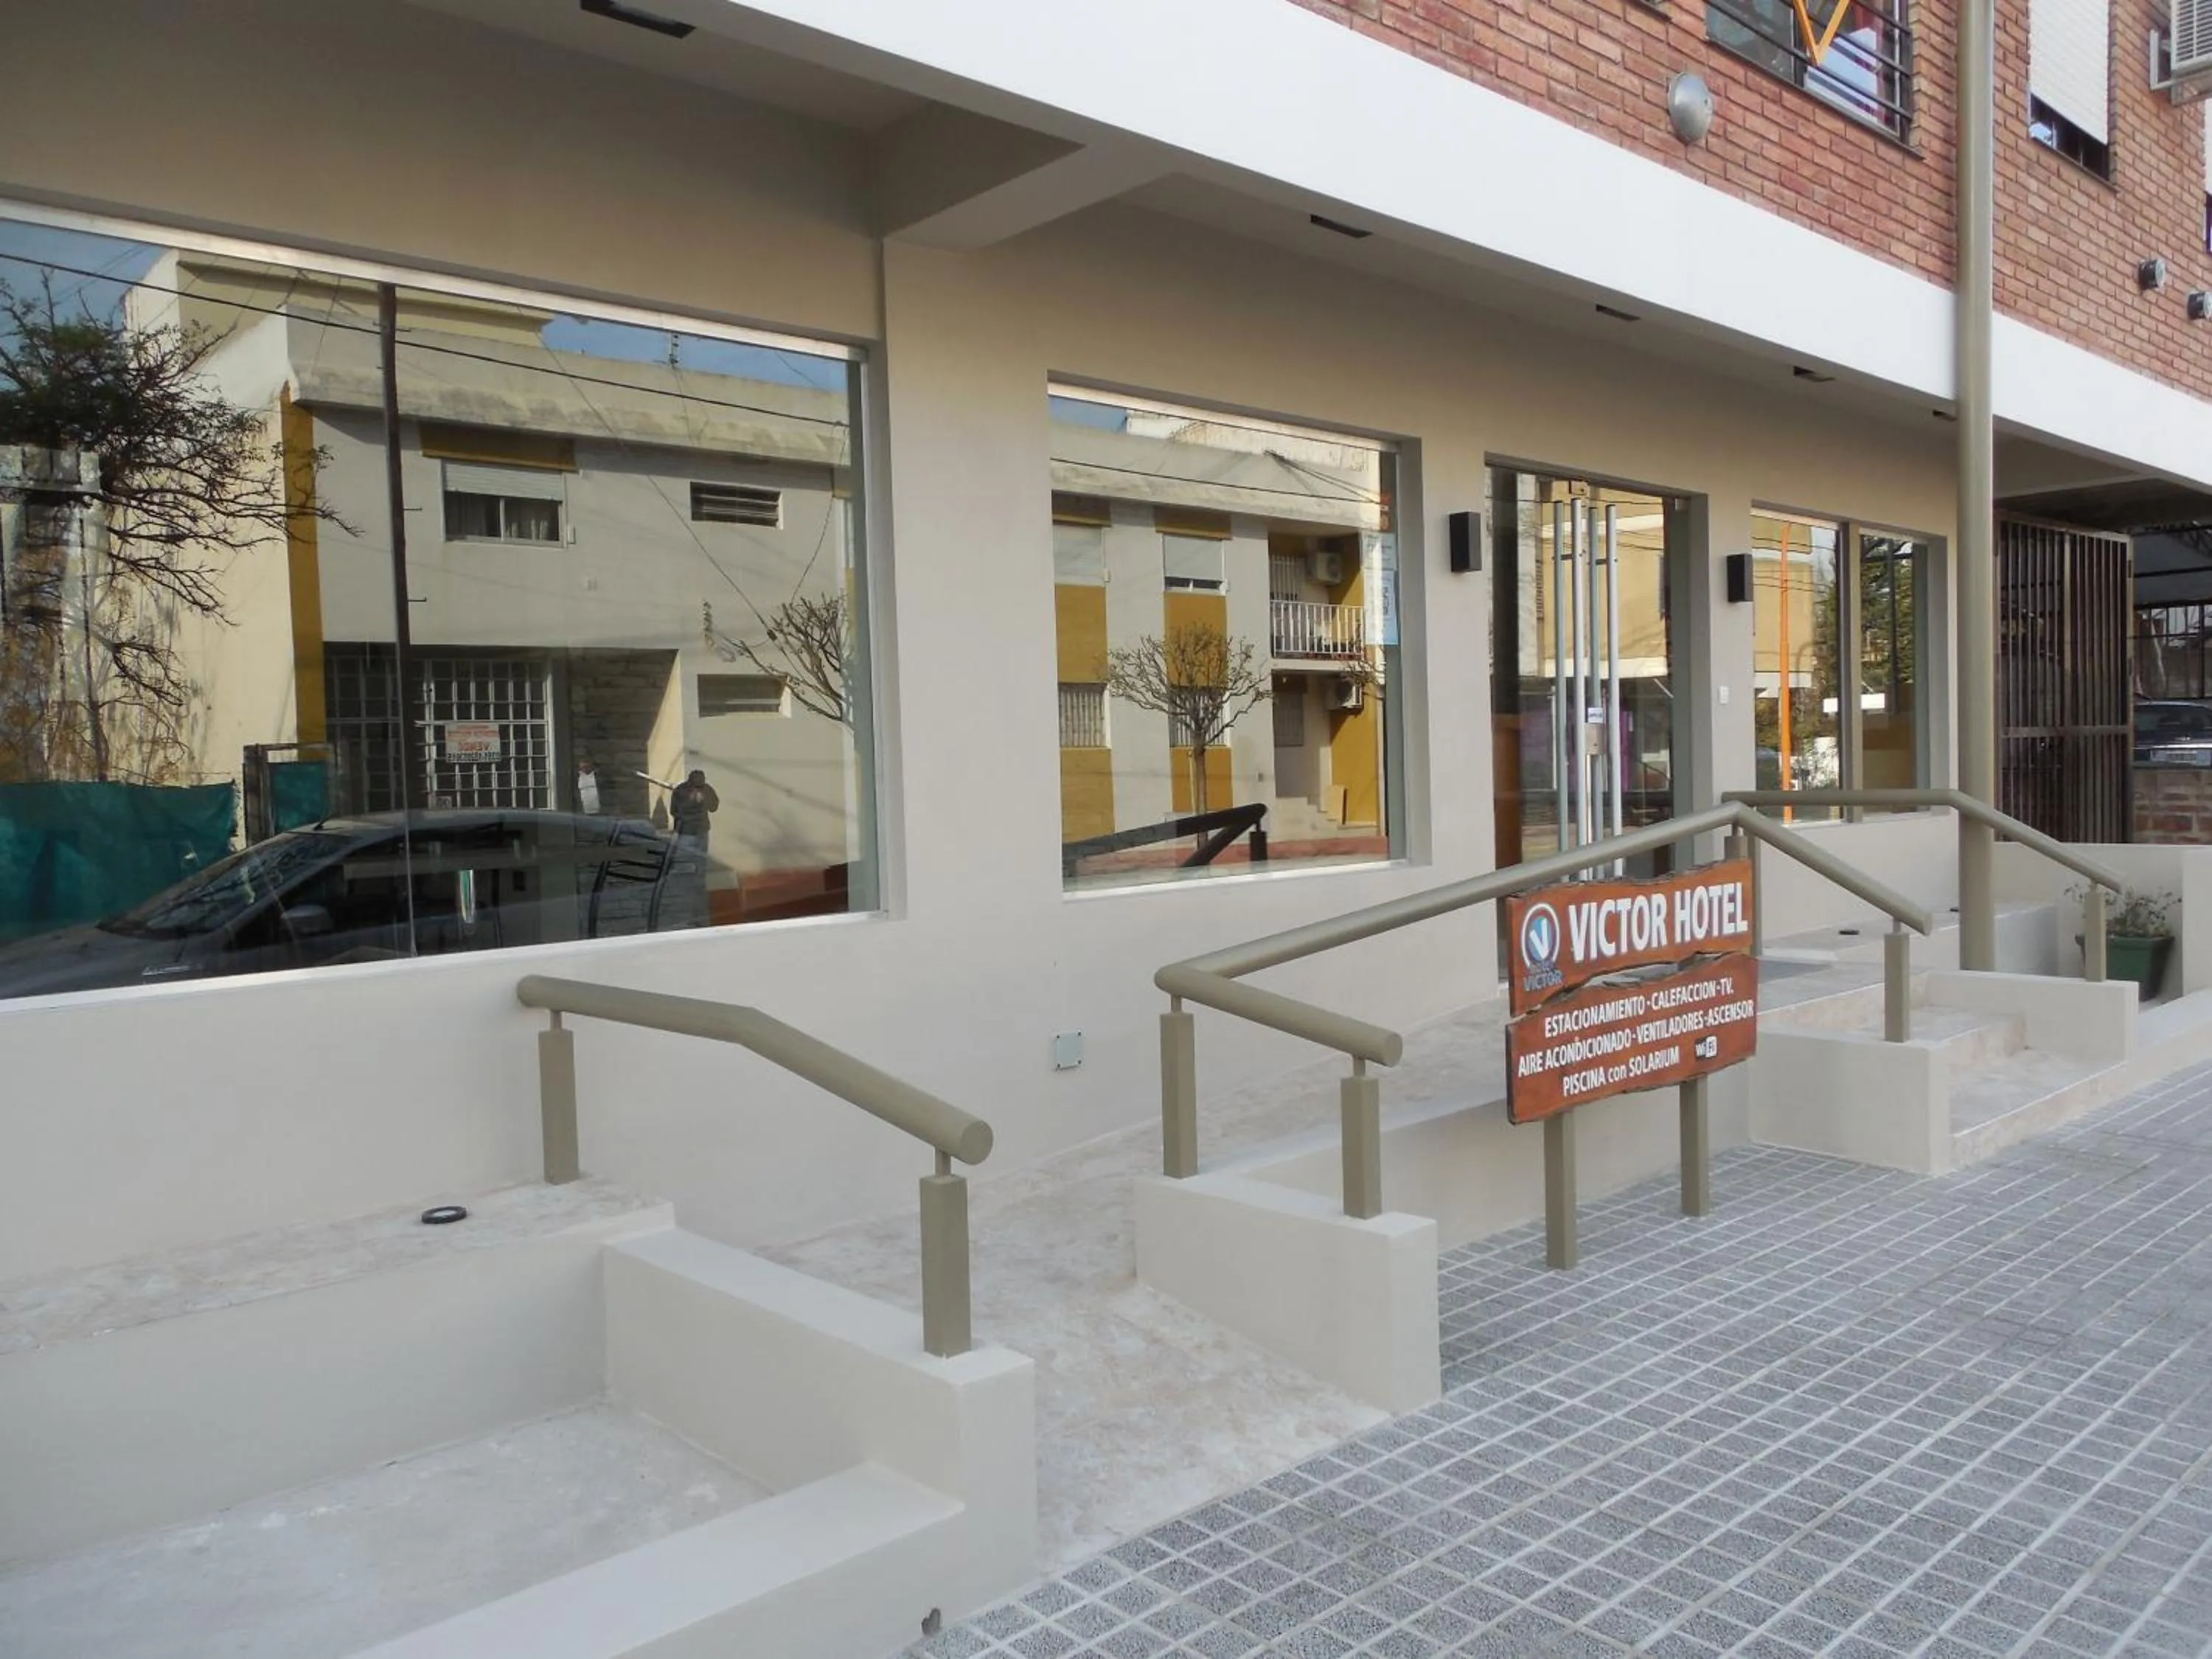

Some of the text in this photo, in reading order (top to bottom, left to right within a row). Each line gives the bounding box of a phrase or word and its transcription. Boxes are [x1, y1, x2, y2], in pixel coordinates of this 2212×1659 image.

[1568, 882, 1748, 963] VICTOR HOTEL
[1518, 1051, 1543, 1077] AIRE
[1562, 1046, 1679, 1097] PISCINA con SOLARIUM
